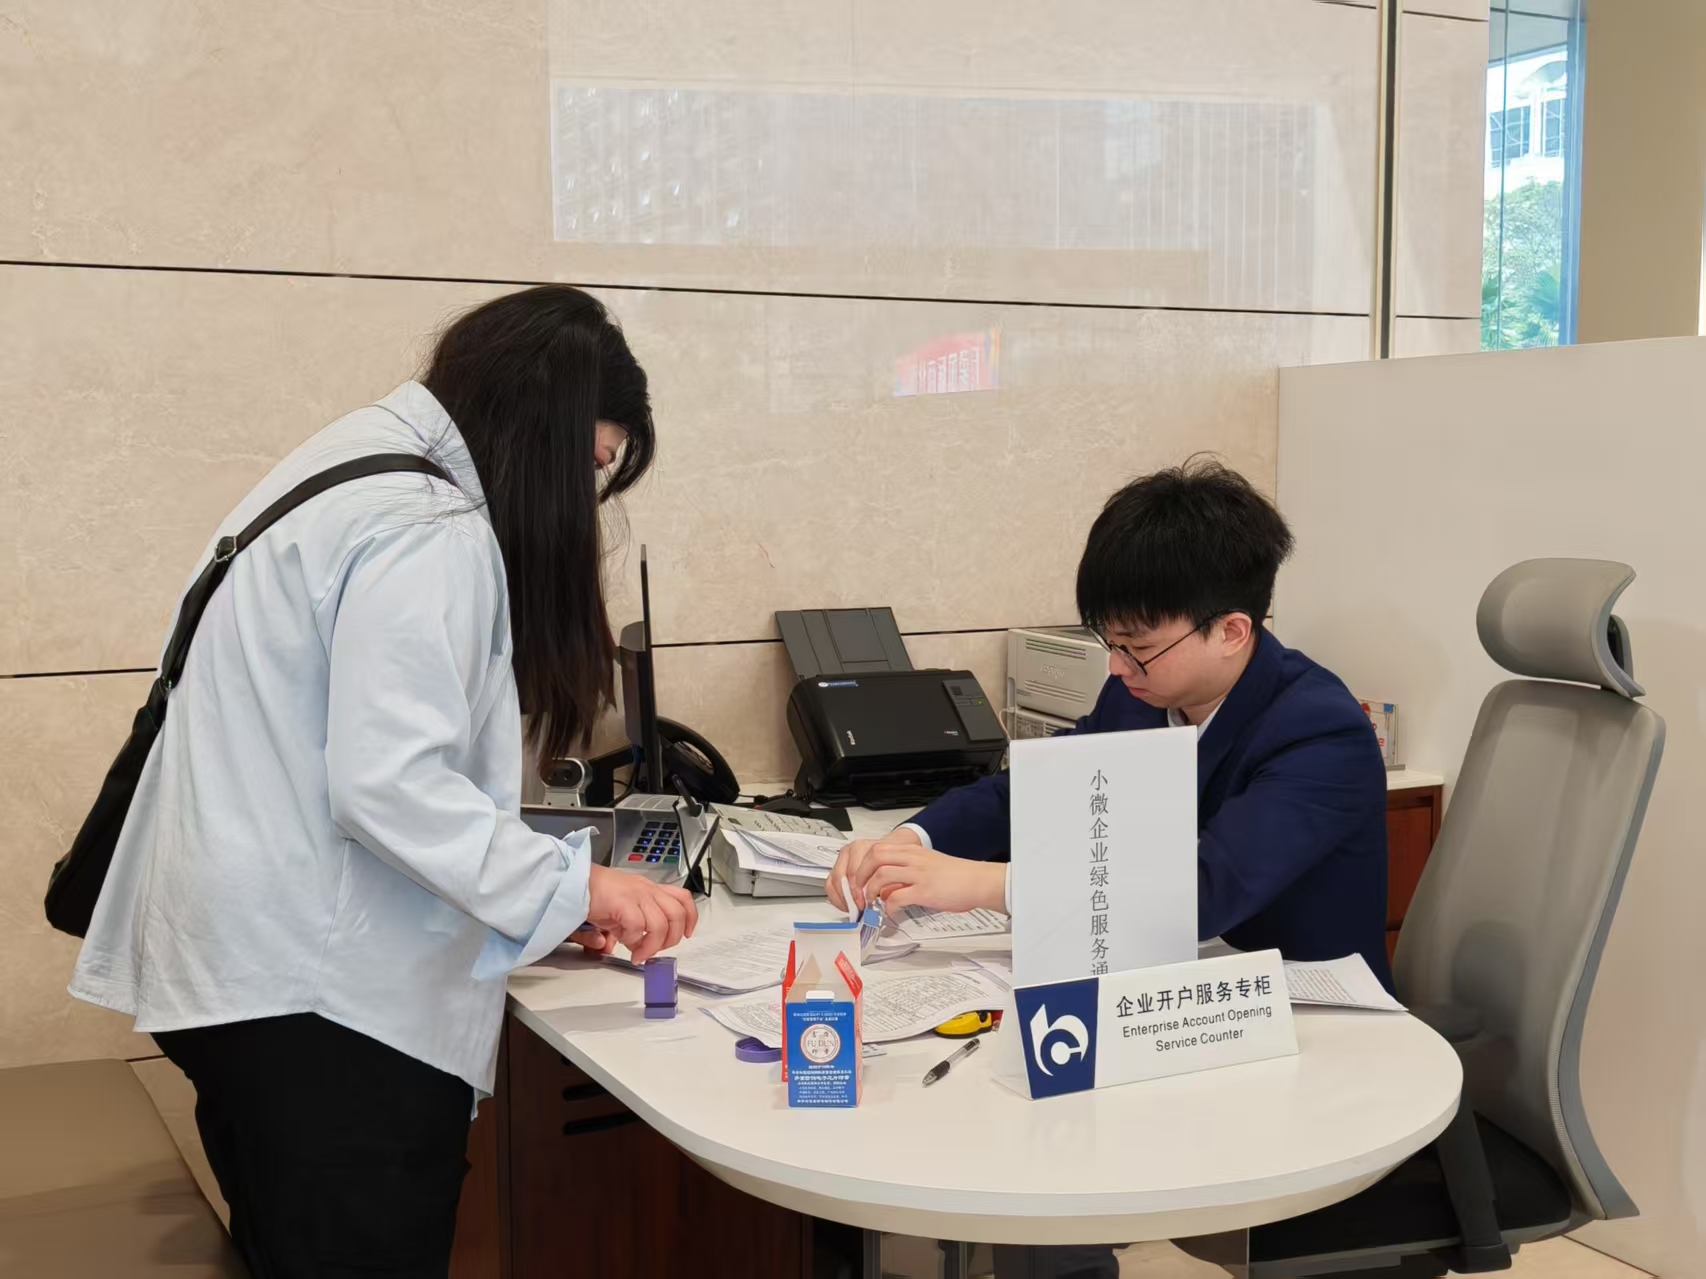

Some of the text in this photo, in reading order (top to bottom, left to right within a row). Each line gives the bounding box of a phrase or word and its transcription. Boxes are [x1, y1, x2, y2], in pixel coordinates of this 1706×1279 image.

[1116, 975, 1273, 1018] 企业开户服务专柜
[1123, 1006, 1272, 1038] Enterprise Account Opening
[1156, 1030, 1244, 1052] Service Counter
